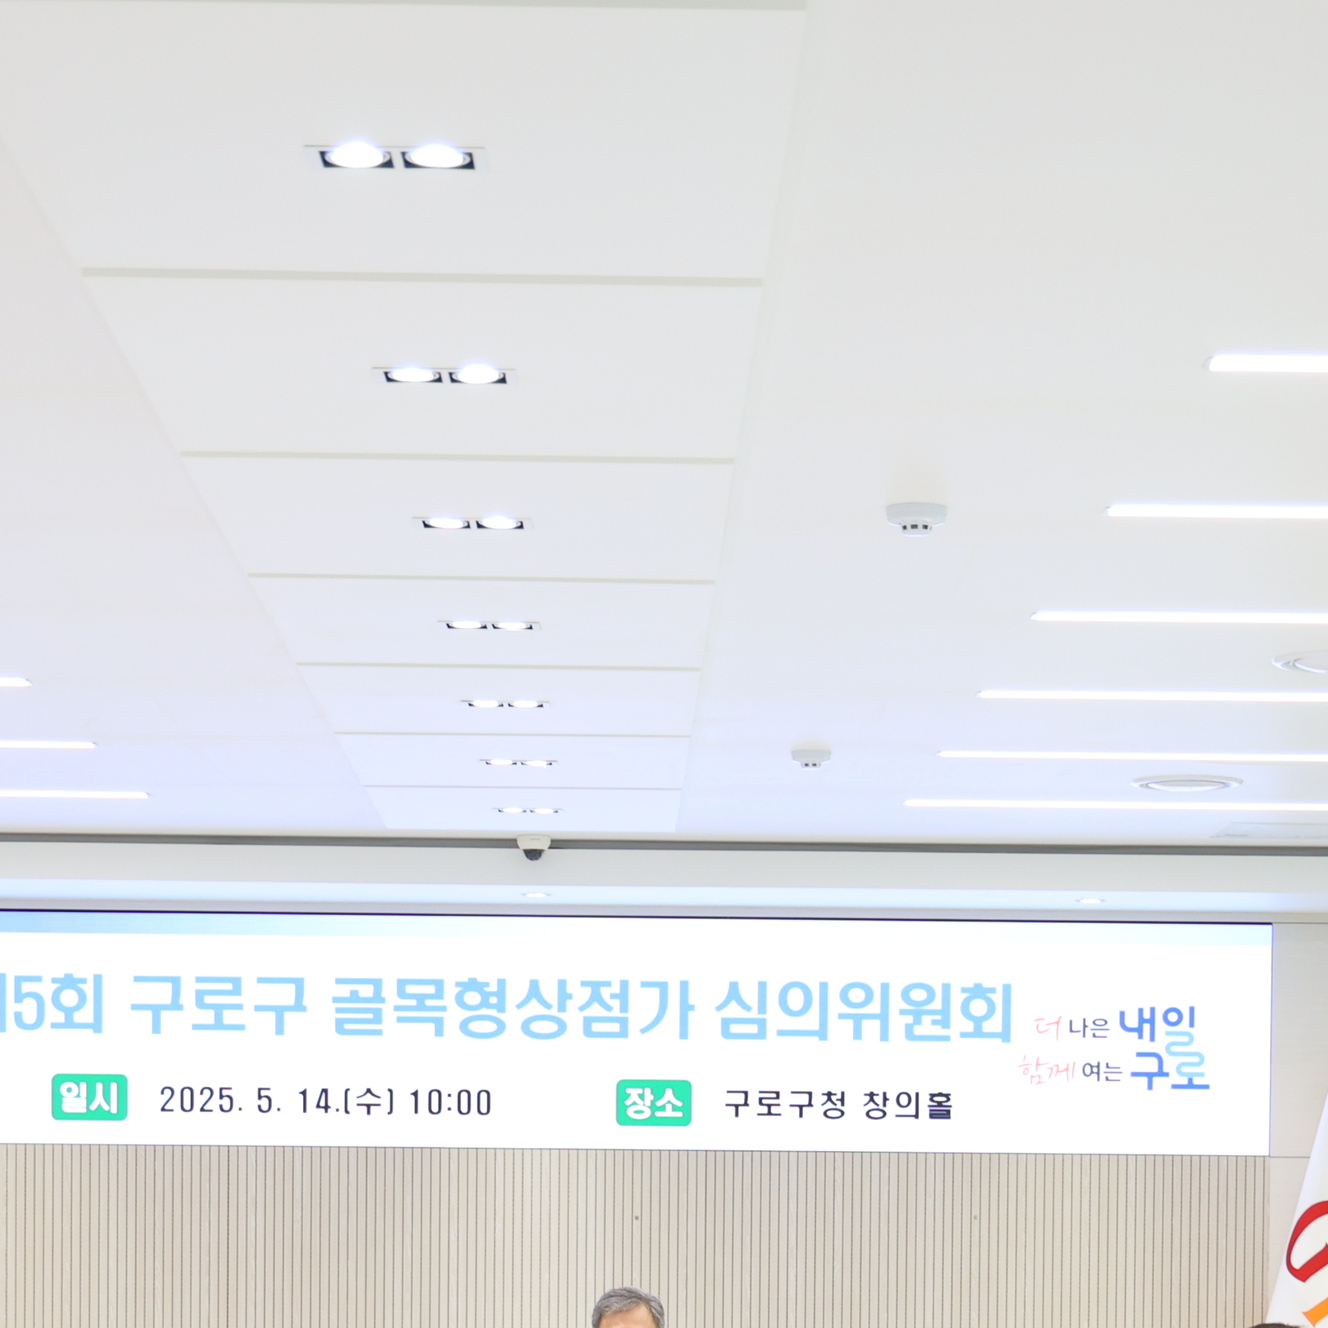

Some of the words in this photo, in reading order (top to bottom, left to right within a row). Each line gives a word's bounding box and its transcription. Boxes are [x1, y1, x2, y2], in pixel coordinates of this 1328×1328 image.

[131, 976, 307, 1035] 구로구
[332, 977, 695, 1040] 골목형상점가
[715, 981, 1012, 1043] 심의위원회
[1033, 1015, 1062, 1041] 더
[1069, 1018, 1110, 1038] 나은
[1119, 1006, 1196, 1055] 내일
[1018, 1055, 1076, 1085] 함께
[1082, 1061, 1123, 1082] 여는
[1130, 1050, 1211, 1090] 구로
[59, 1081, 118, 1114] 일시
[160, 1086, 243, 1114] 2025.
[257, 1087, 281, 1114] 5.
[410, 1089, 492, 1116] 10:00
[623, 1087, 684, 1120] 장소
[725, 1090, 846, 1120] 구로구청
[863, 1091, 953, 1120] 창의홀
